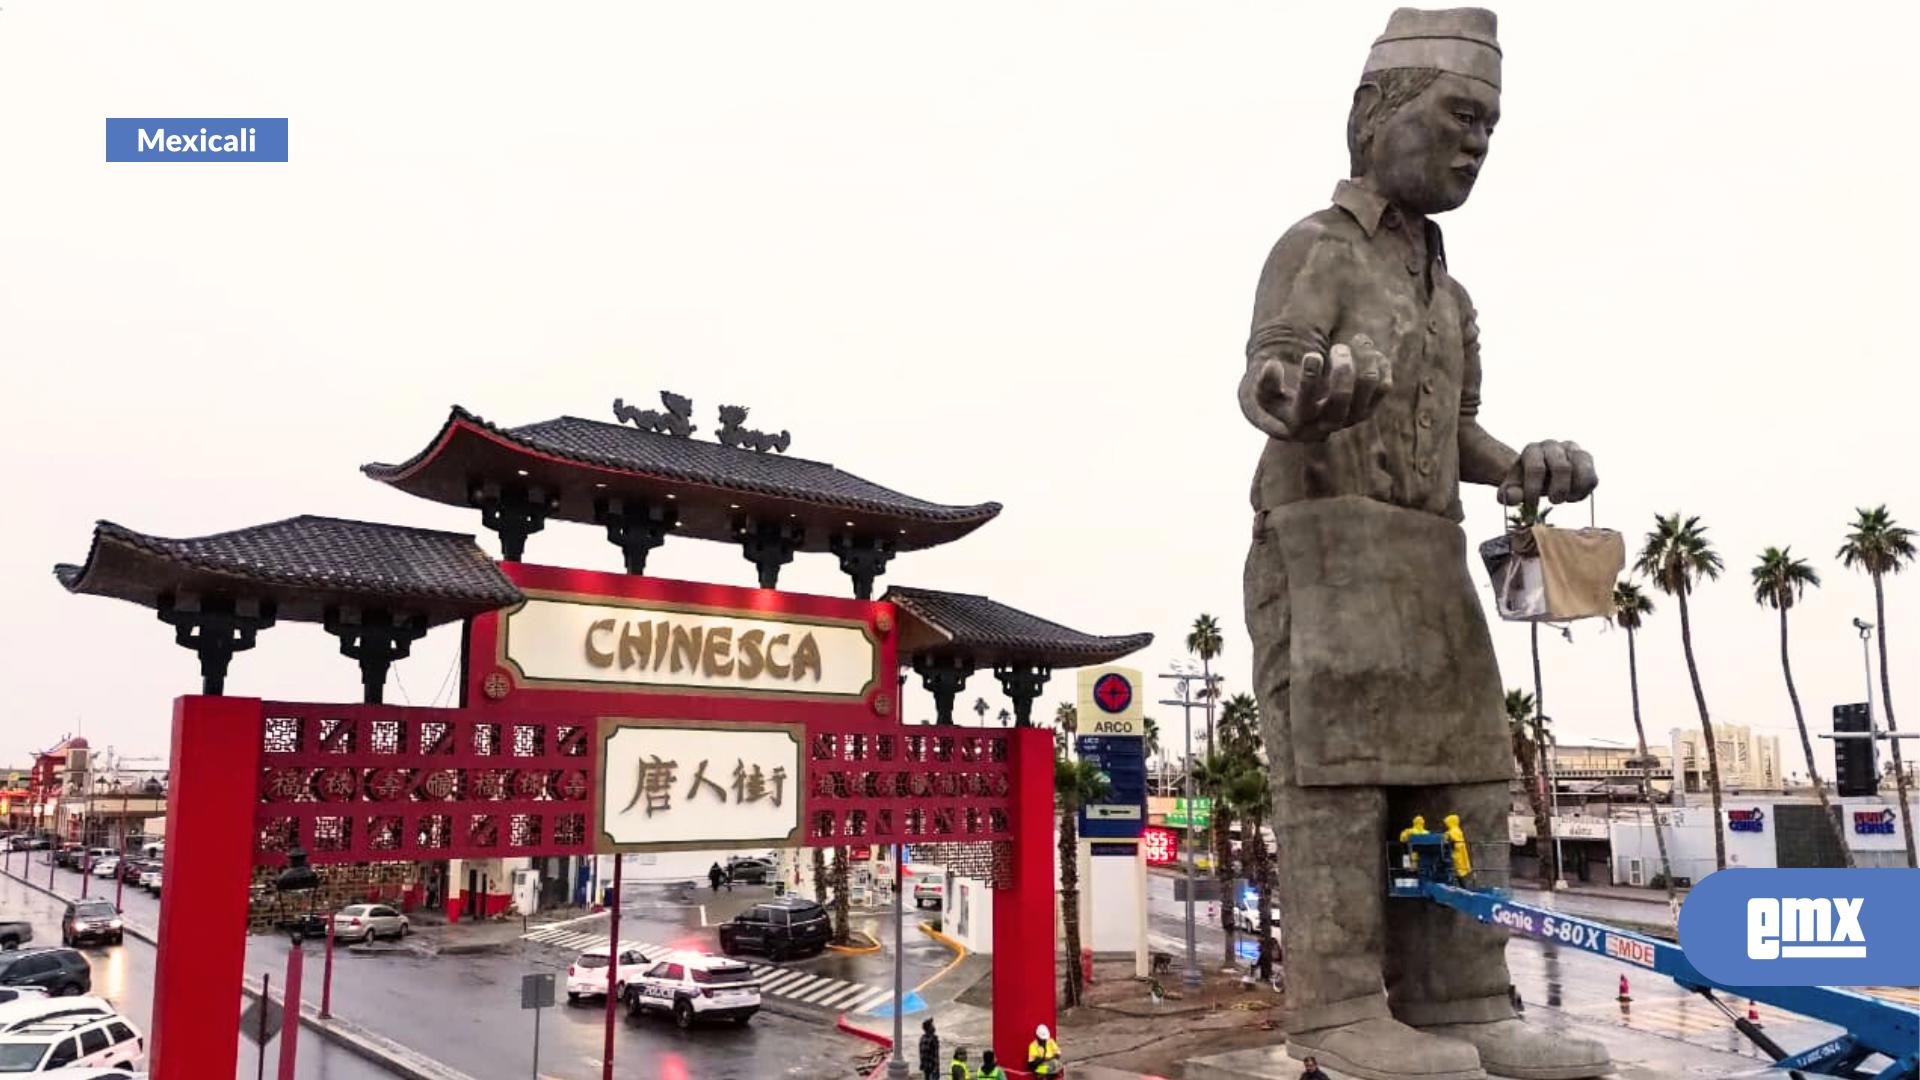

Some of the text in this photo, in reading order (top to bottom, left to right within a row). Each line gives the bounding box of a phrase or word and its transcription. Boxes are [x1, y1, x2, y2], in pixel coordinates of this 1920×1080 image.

[585, 619, 822, 683] CHINESCA
[1094, 721, 1133, 733] ARCO
[620, 754, 788, 818] 唐人街
[1491, 903, 1533, 931] Genie
